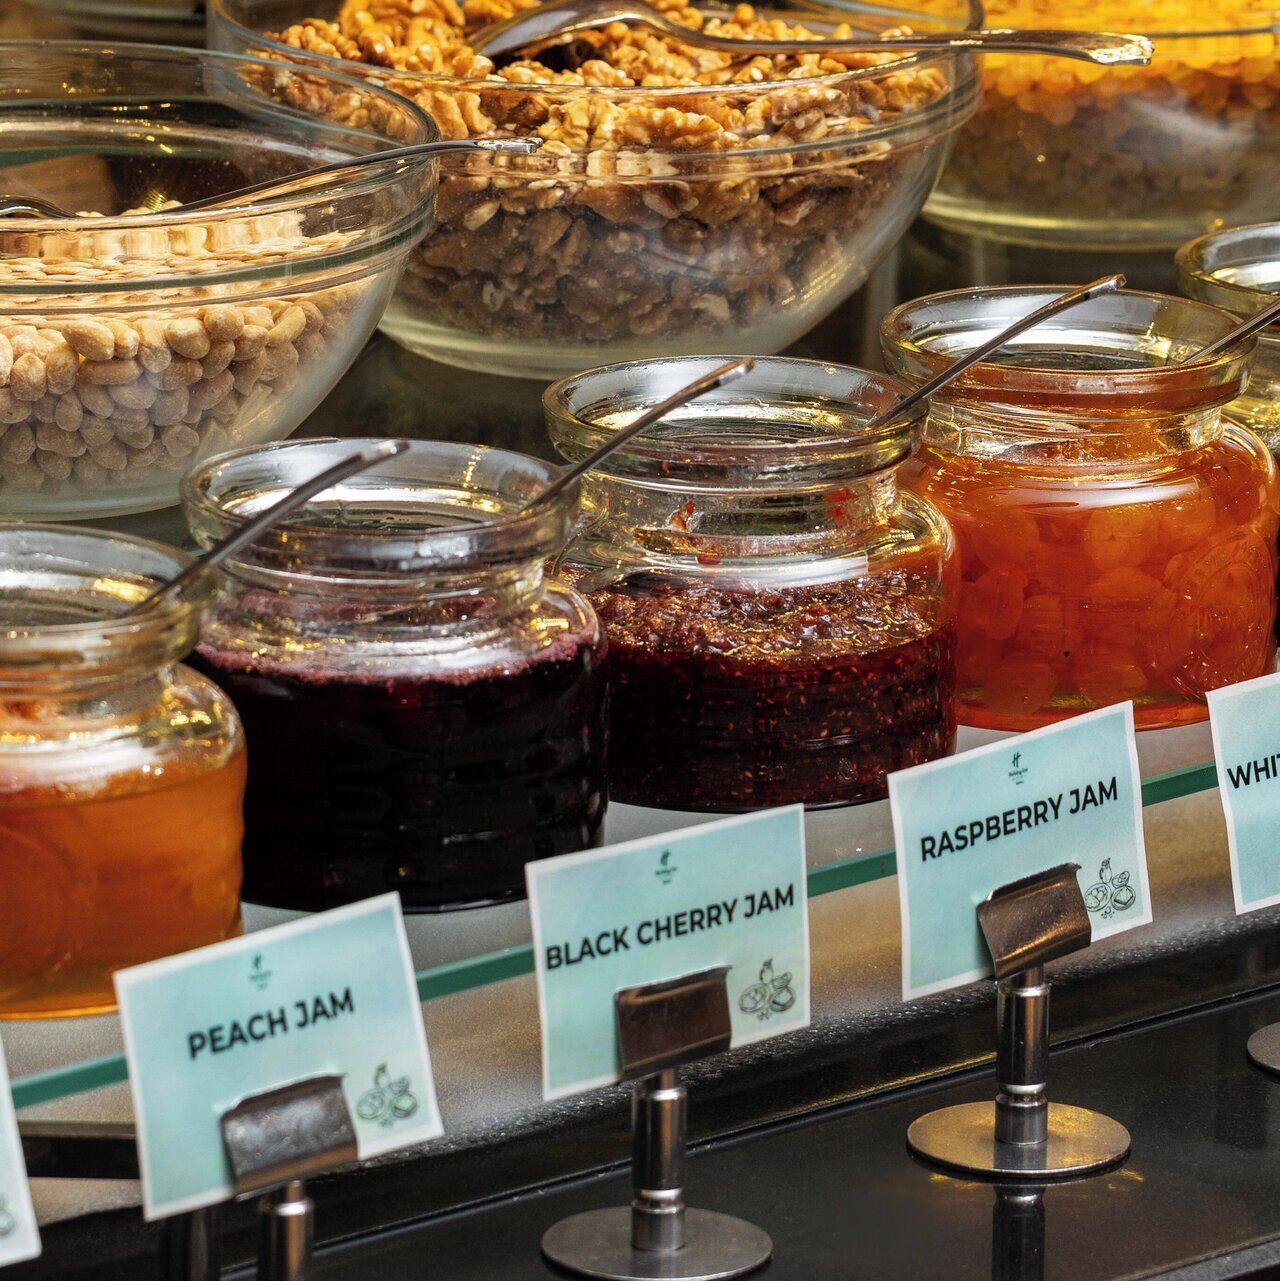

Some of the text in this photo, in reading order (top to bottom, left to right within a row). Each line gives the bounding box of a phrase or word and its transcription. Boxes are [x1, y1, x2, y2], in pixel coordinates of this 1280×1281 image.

[921, 776, 1119, 862] RASPBERRY JAM
[546, 884, 795, 969] BLACK CHERRY JAM
[188, 987, 355, 1059] PEACH JAM
